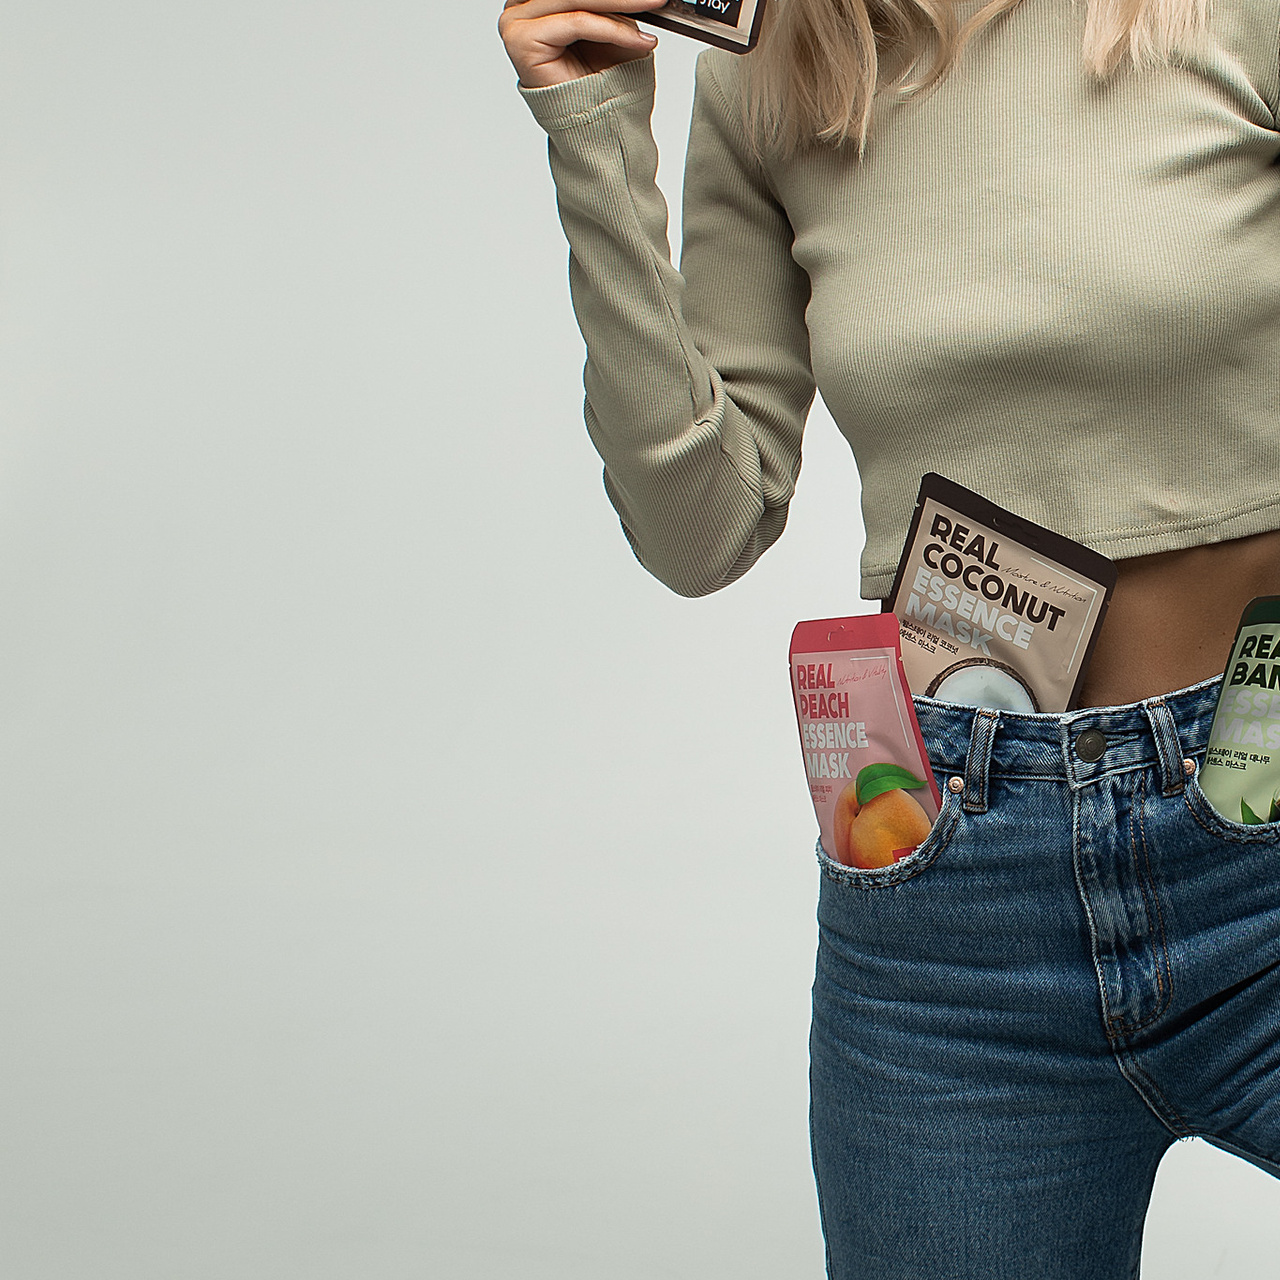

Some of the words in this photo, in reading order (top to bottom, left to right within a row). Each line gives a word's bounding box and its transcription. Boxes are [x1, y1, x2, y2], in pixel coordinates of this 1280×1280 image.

[930, 513, 1000, 571] REAL
[922, 543, 1066, 632] COCONUT
[913, 566, 1035, 651] ESSENCE
[905, 593, 993, 657] MASK
[917, 639, 937, 655] 마스크
[939, 639, 960, 656] 코코넛
[797, 663, 836, 690] REAL
[799, 692, 850, 719] PEACH
[803, 722, 869, 749] ESSENCE
[806, 752, 852, 778] MASK
[1225, 759, 1247, 770] 마스크
